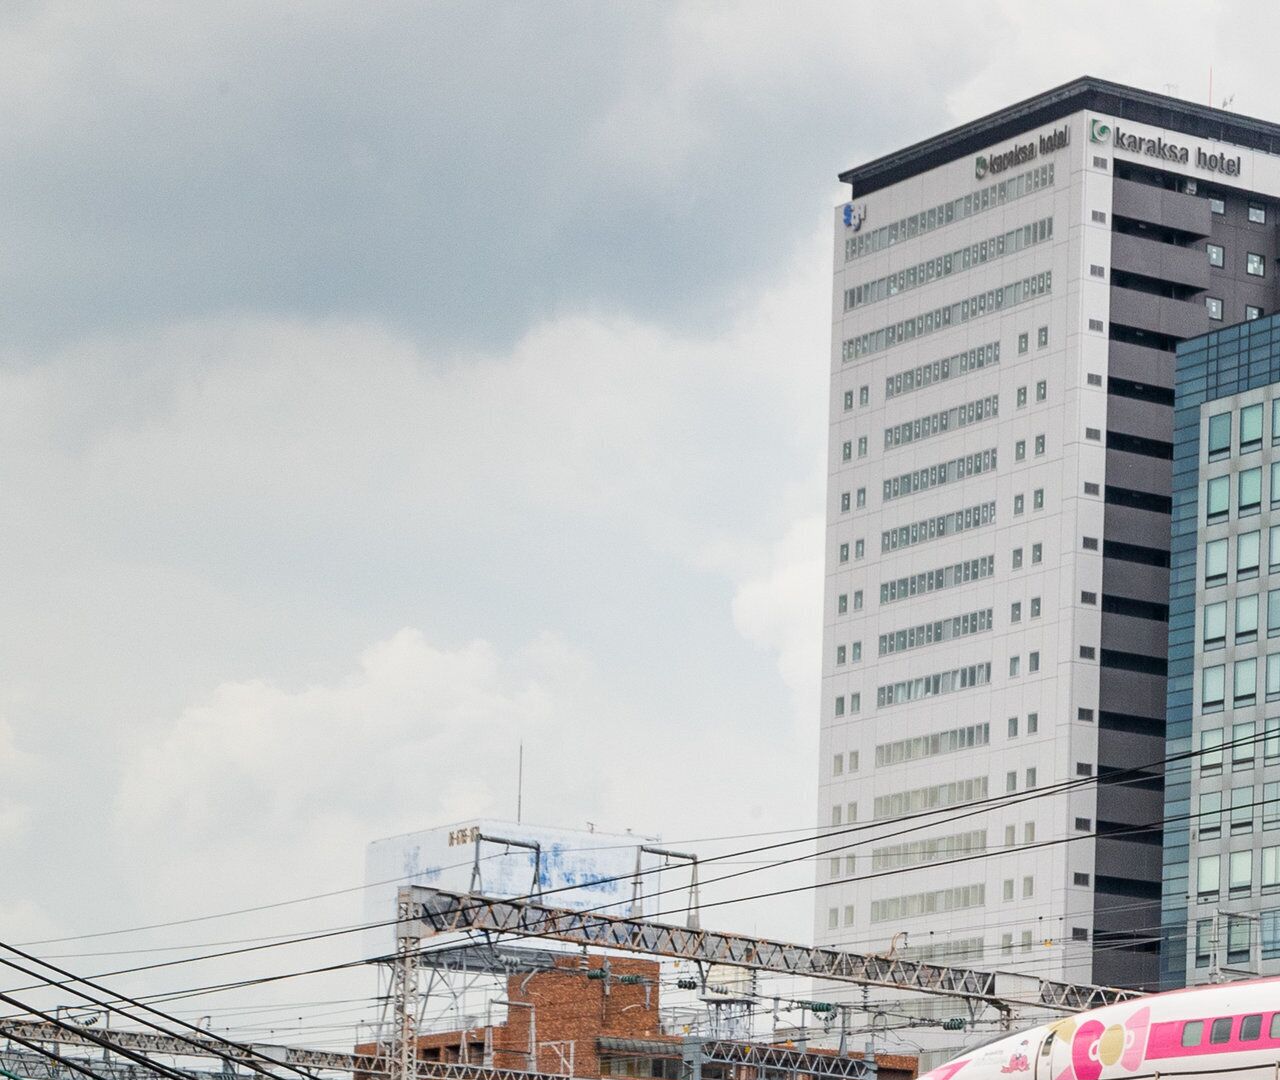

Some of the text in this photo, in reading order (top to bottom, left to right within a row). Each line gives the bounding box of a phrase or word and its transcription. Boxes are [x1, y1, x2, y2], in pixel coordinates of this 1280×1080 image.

[989, 125, 1070, 174] karaksa hotel
[1114, 127, 1241, 177] karaksa hotel
